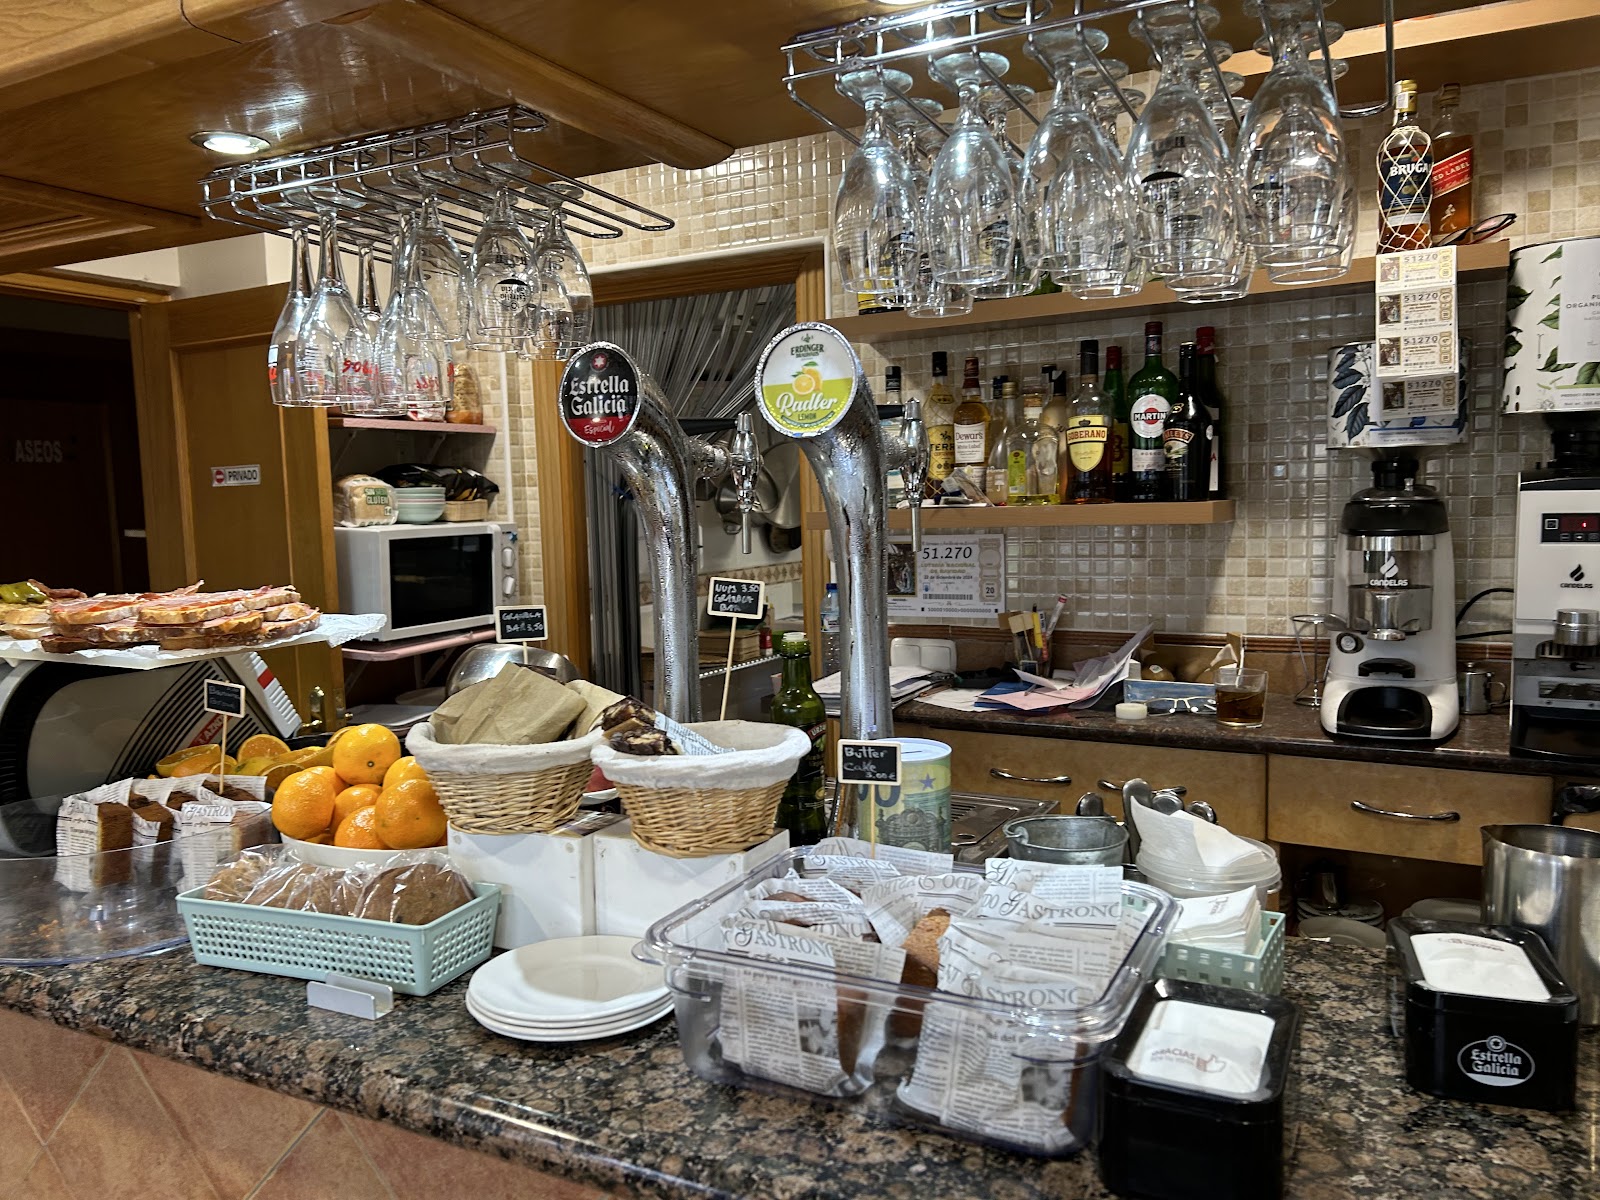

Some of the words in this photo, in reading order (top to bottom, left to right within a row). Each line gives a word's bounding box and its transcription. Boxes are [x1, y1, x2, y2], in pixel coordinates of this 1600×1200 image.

[1404, 253, 1438, 263] 51270
[1404, 292, 1439, 303] 51270
[1403, 335, 1438, 346] 51270
[790, 343, 825, 356] ERDINGER
[569, 376, 629, 397] Estrella
[1407, 380, 1442, 390] 51270
[570, 394, 626, 416] Galicia
[776, 391, 838, 417] Radler
[955, 431, 983, 442] Dewar's
[1067, 429, 1106, 440] SOBERANO
[15, 440, 63, 463] ASEOS
[929, 443, 955, 451] TERR
[228, 469, 258, 482] PRIVADO
[922, 546, 972, 560] 51.270
[1369, 579, 1409, 587] CANDELAS
[844, 747, 886, 758] Butter
[843, 760, 877, 773] Cake
[1470, 1048, 1522, 1065] Estrella
[1472, 1060, 1520, 1076] Galicia
